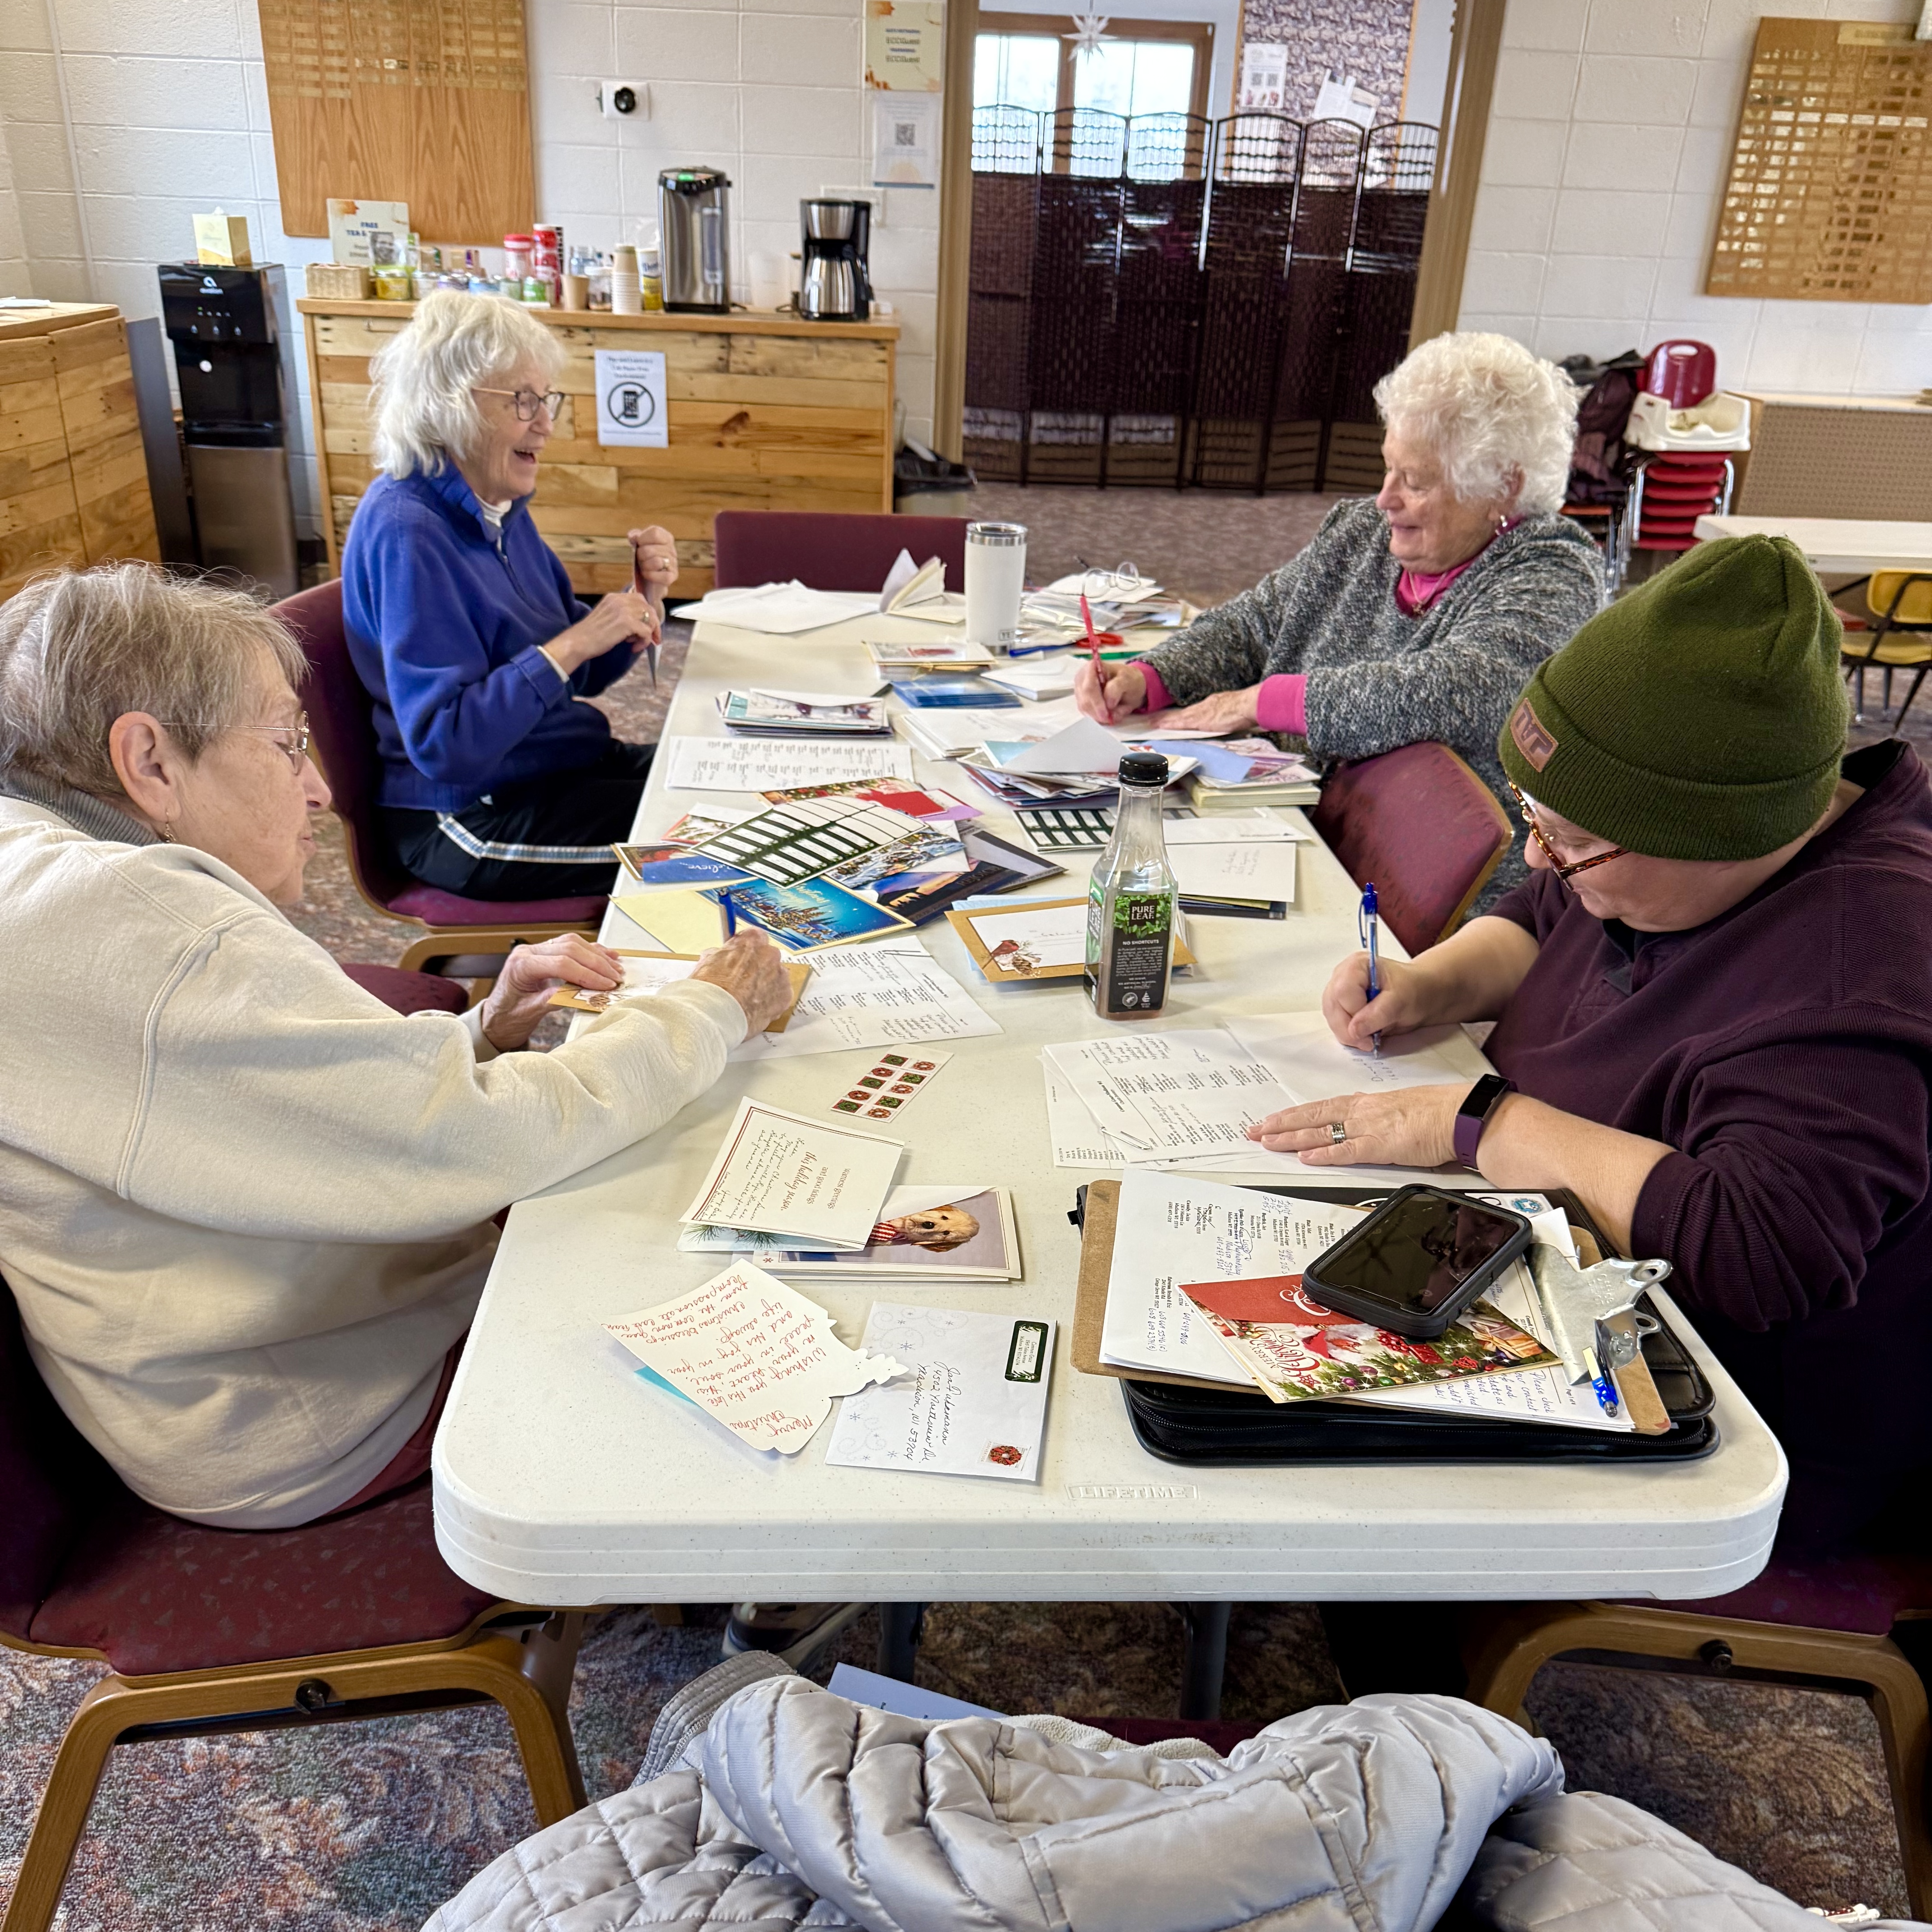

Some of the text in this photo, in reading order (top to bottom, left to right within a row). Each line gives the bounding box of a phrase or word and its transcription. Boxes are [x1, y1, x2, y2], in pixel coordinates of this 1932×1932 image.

[800, 1151, 818, 1164] this
[784, 1164, 813, 1190] holiday
[806, 1167, 828, 1205] and good tidings
[827, 1168, 851, 1209] Warmest greetings
[720, 1274, 749, 1302] from
[698, 1303, 717, 1314] the
[768, 1311, 793, 1333] and
[779, 1314, 815, 1344] peace
[716, 1341, 741, 1359] joy
[772, 1342, 800, 1365] your
[1249, 1346, 1279, 1368] MERRY
[1250, 1327, 1320, 1377] Christmas
[667, 1358, 695, 1374] your
[727, 1353, 754, 1375] your
[768, 1347, 827, 1379] Wishing
[930, 1370, 942, 1391] 4502
[1447, 1383, 1462, 1398] add
[1488, 1375, 1504, 1396] date
[1529, 1370, 1555, 1413] Please check
[1505, 1385, 1518, 1399] and
[1521, 1387, 1539, 1412] contact
[766, 1415, 814, 1437] Merry
[911, 1413, 920, 1425] WI
[903, 1428, 919, 1461] 53704
[1079, 1486, 1187, 1498] LIFETIME
